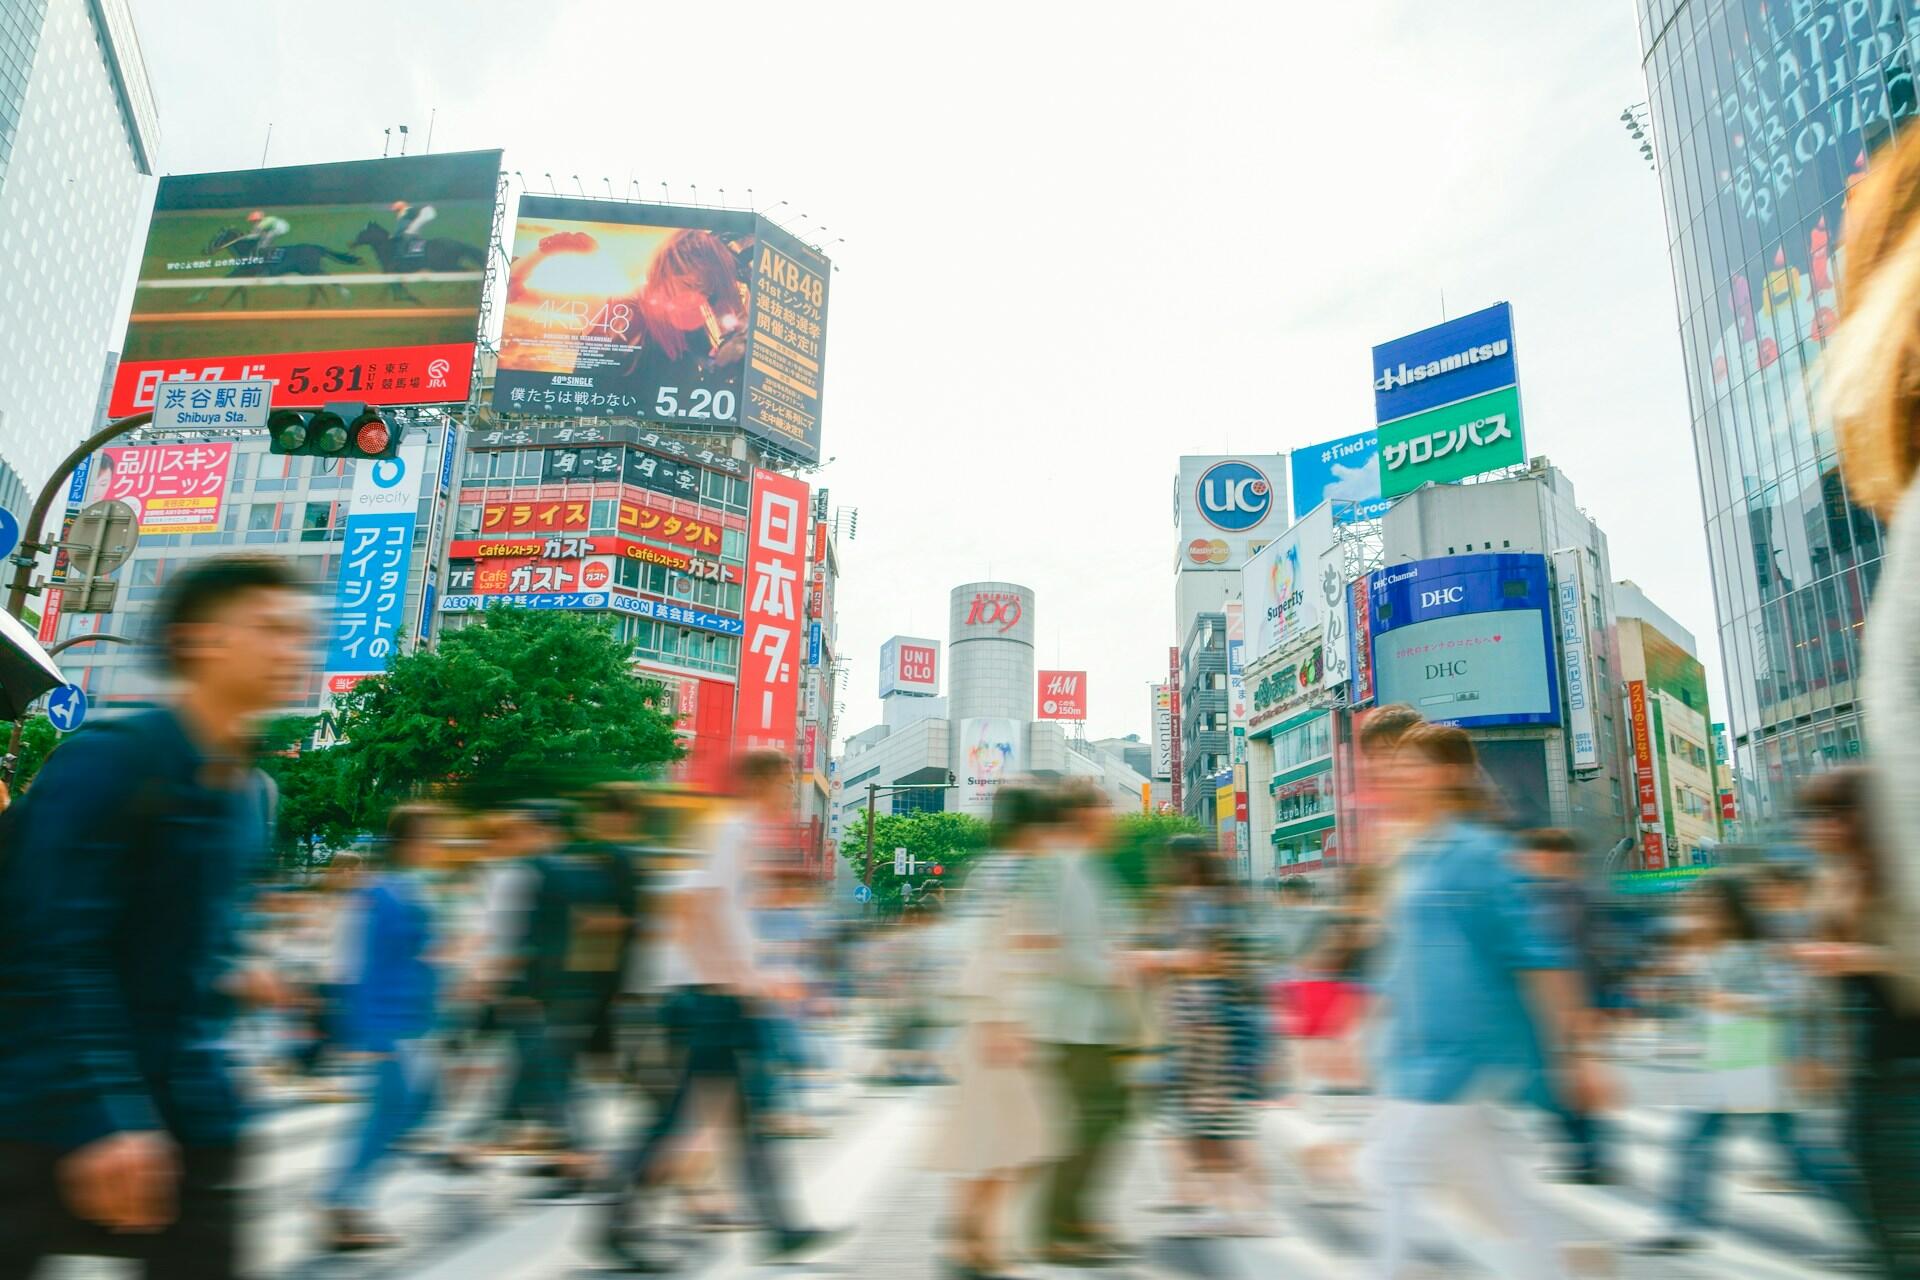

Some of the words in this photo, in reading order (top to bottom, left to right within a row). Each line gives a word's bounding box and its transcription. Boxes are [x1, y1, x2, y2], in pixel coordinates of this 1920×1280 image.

[758, 247, 823, 308] AKB48
[783, 290, 821, 320] シングル
[385, 362, 408, 373] 東京
[1374, 338, 1508, 391] Hisamitsu
[288, 364, 363, 394] 5.31
[566, 377, 594, 386] SINGLE
[164, 388, 262, 409] 渋谷駅前
[510, 388, 637, 407] 僕たちは戦わない
[655, 386, 737, 421] 5.20
[177, 412, 221, 424] Shibuya
[224, 411, 247, 422] Sta.
[1382, 413, 1512, 471] サロンパス
[116, 448, 228, 475] 品川スキン
[552, 452, 618, 472] 月の宴
[113, 472, 223, 498] クリニック
[634, 458, 696, 490] 月の宴
[359, 491, 411, 505] eyecity
[485, 504, 587, 528] プライス
[619, 504, 719, 546] コンタクト
[543, 539, 595, 558] ガスト
[450, 571, 474, 587] 7F
[480, 569, 507, 582] Café
[508, 565, 573, 592] ガスト
[585, 573, 607, 581] ガスト
[687, 558, 734, 583] ガスト
[1373, 579, 1388, 590] DHC
[1388, 569, 1418, 584] Channel
[338, 527, 381, 659] アイシティ
[368, 526, 405, 658] コンタクトの
[443, 597, 479, 608] AEON
[1421, 586, 1464, 609] DHC
[615, 596, 649, 613] AEON
[965, 600, 1022, 633] 109
[1267, 590, 1304, 622] Superfly
[656, 603, 742, 632] 英会話イーオン
[904, 650, 929, 664] UNI
[903, 665, 931, 679] QLO
[1425, 659, 1468, 680] DHC
[1566, 650, 1585, 711] neon
[1047, 676, 1077, 696] H&M
[1059, 706, 1080, 714] 150m
[1631, 684, 1648, 762] クスリのことなら
[1157, 708, 1170, 775] Essential
